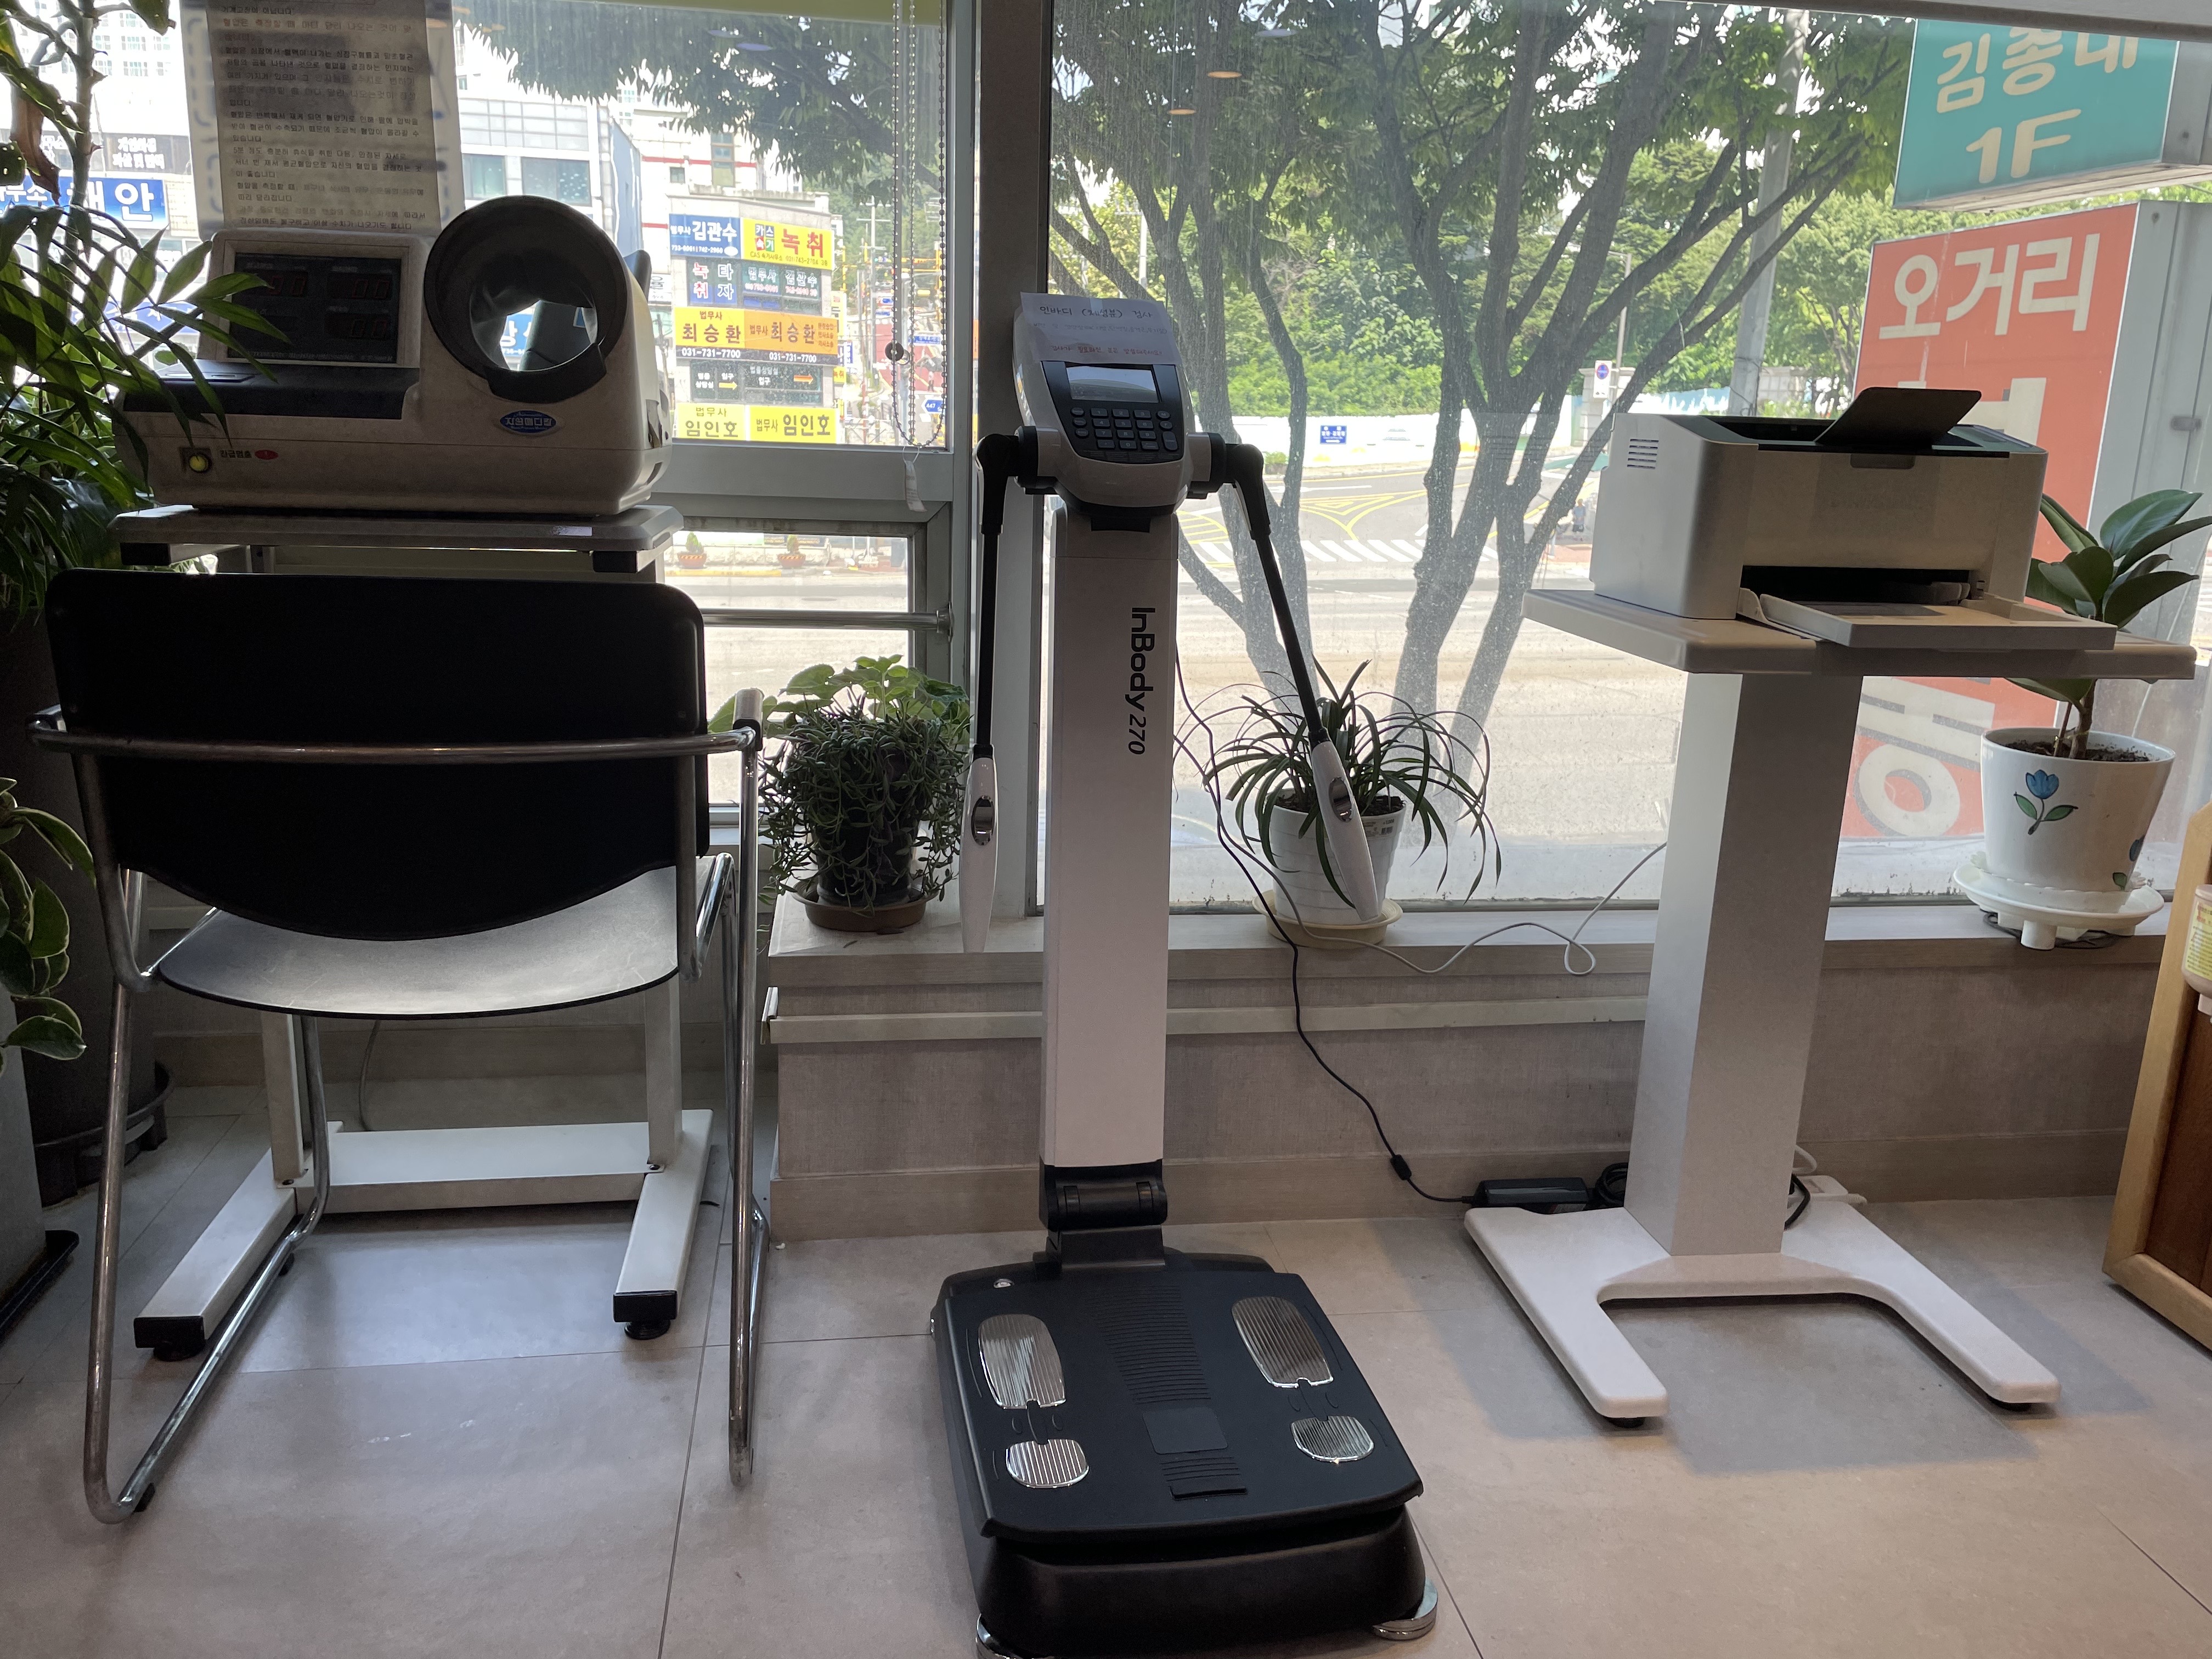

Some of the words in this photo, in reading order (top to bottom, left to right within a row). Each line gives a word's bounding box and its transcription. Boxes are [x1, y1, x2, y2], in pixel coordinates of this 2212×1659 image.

[348, 22, 374, 32] 나오는
[1966, 109, 2081, 184] 1F
[670, 225, 691, 235] 법무사
[692, 221, 737, 242] 김관수
[1878, 233, 2100, 340] 오거리
[699, 311, 723, 321] 법무사
[1039, 306, 1073, 317] 인바디
[1131, 310, 1154, 319] 검사
[682, 323, 741, 345] 최승환
[749, 324, 769, 336] 법무사
[770, 321, 815, 345] 최승환
[681, 347, 741, 359] 031-731-7700
[769, 352, 817, 364] 031-731-7700
[696, 407, 727, 417] 법무사
[685, 420, 738, 438] 임인호
[756, 418, 778, 432] 법무사
[782, 414, 831, 437] 임인호
[1125, 607, 1156, 712] InBody
[1127, 713, 1147, 755] 270
